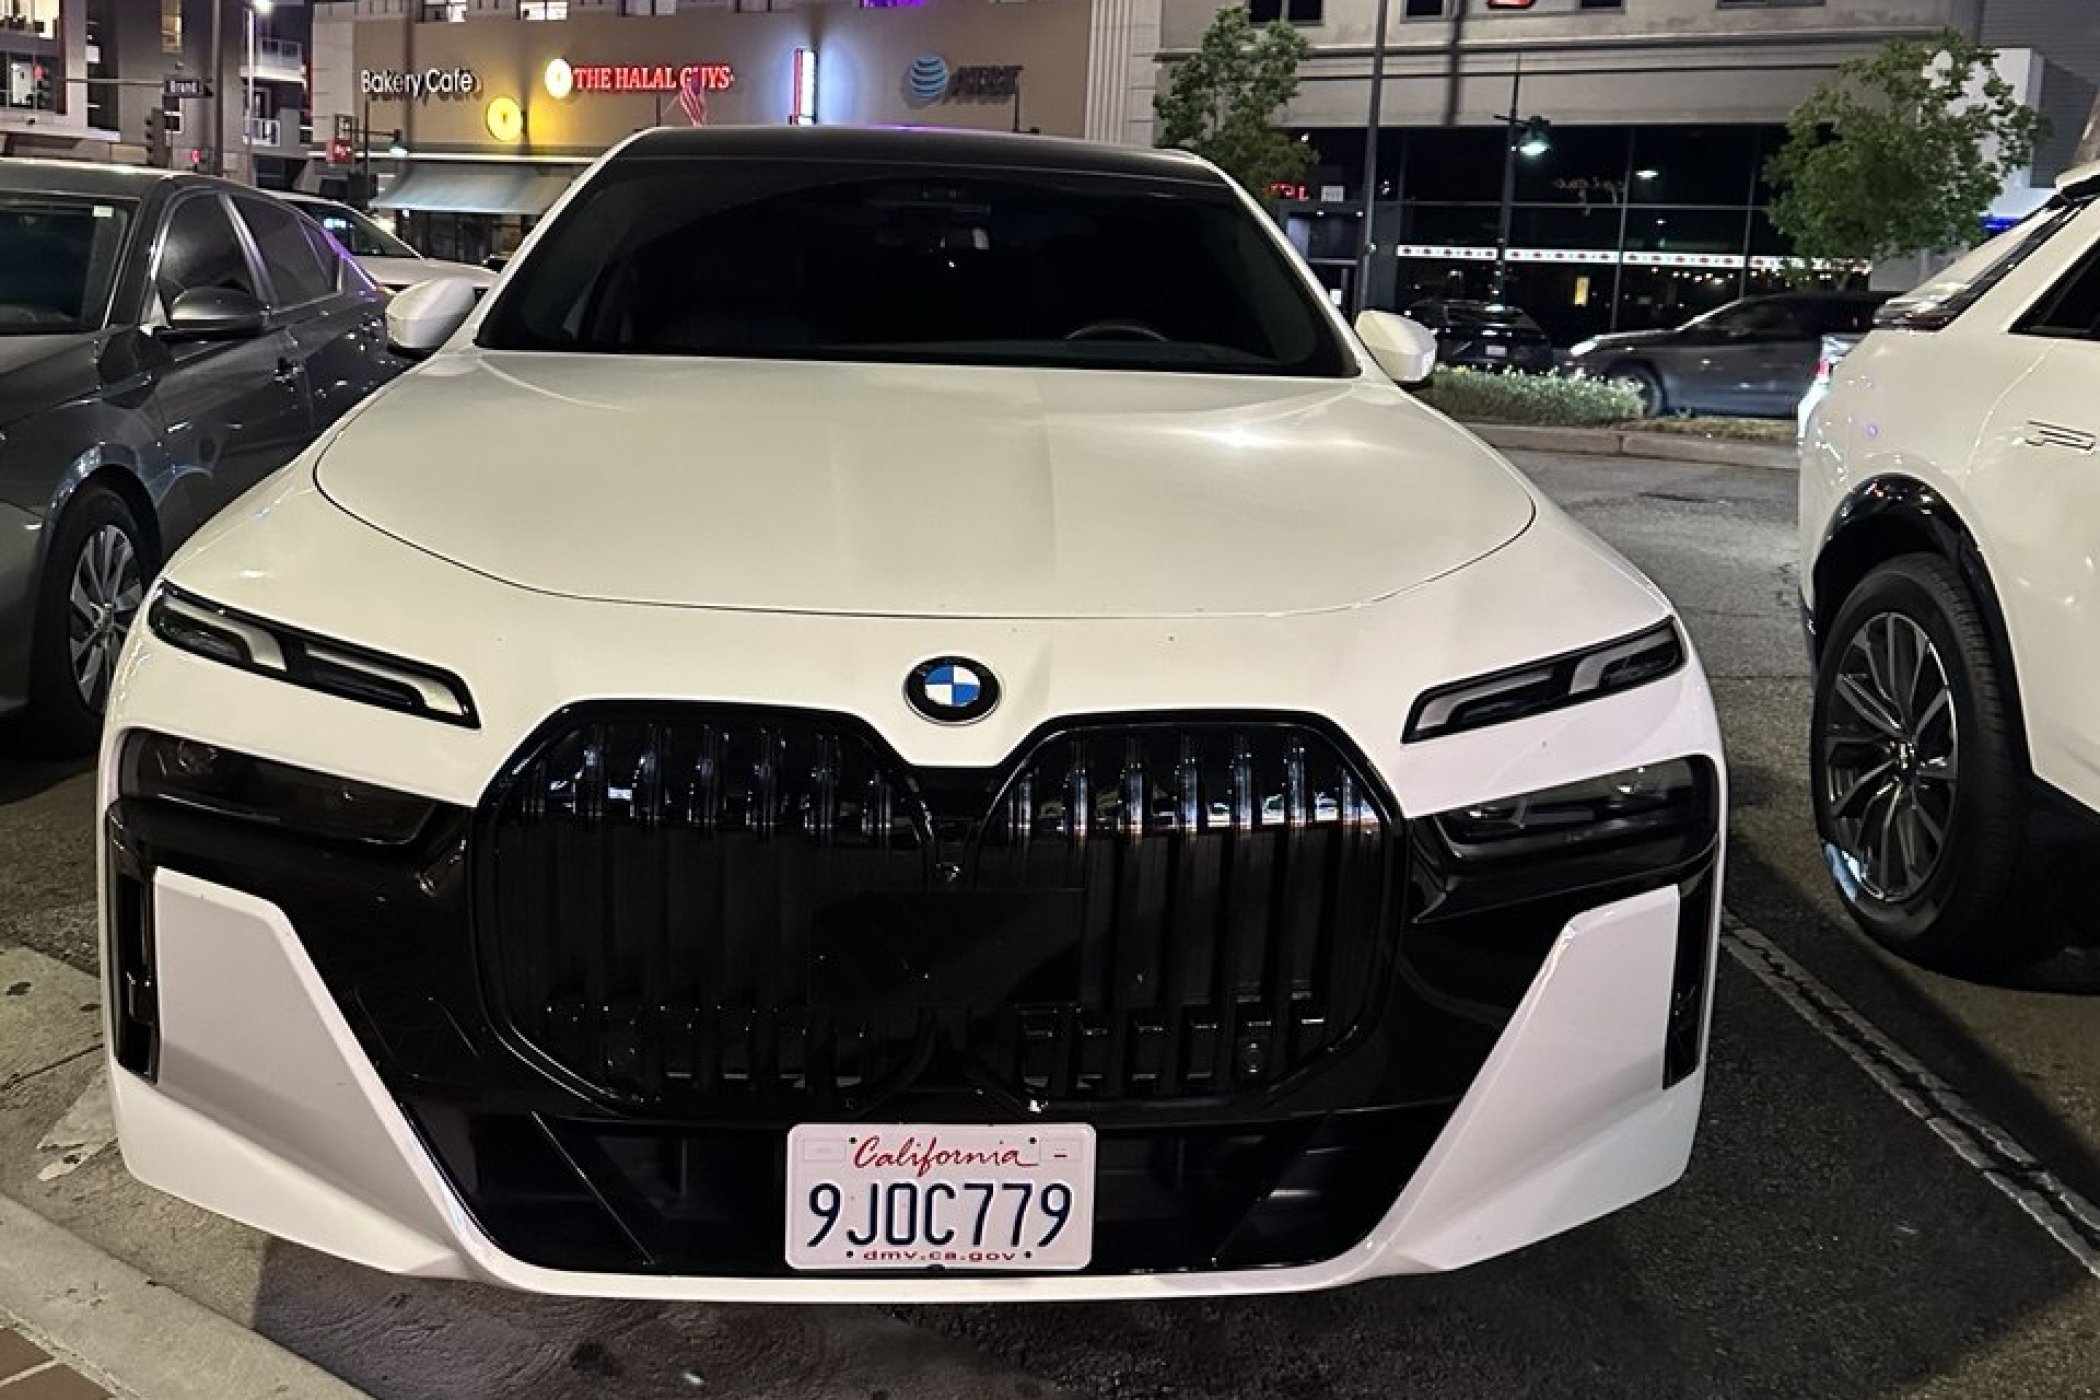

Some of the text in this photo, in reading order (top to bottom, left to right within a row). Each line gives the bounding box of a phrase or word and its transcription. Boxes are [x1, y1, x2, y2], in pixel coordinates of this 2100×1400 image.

[361, 69, 420, 98] Bakery
[573, 67, 612, 89] THE
[616, 67, 677, 89] HALAL
[852, 1135, 1039, 1177] California
[863, 1251, 1017, 1261] dmv.ca.gov
